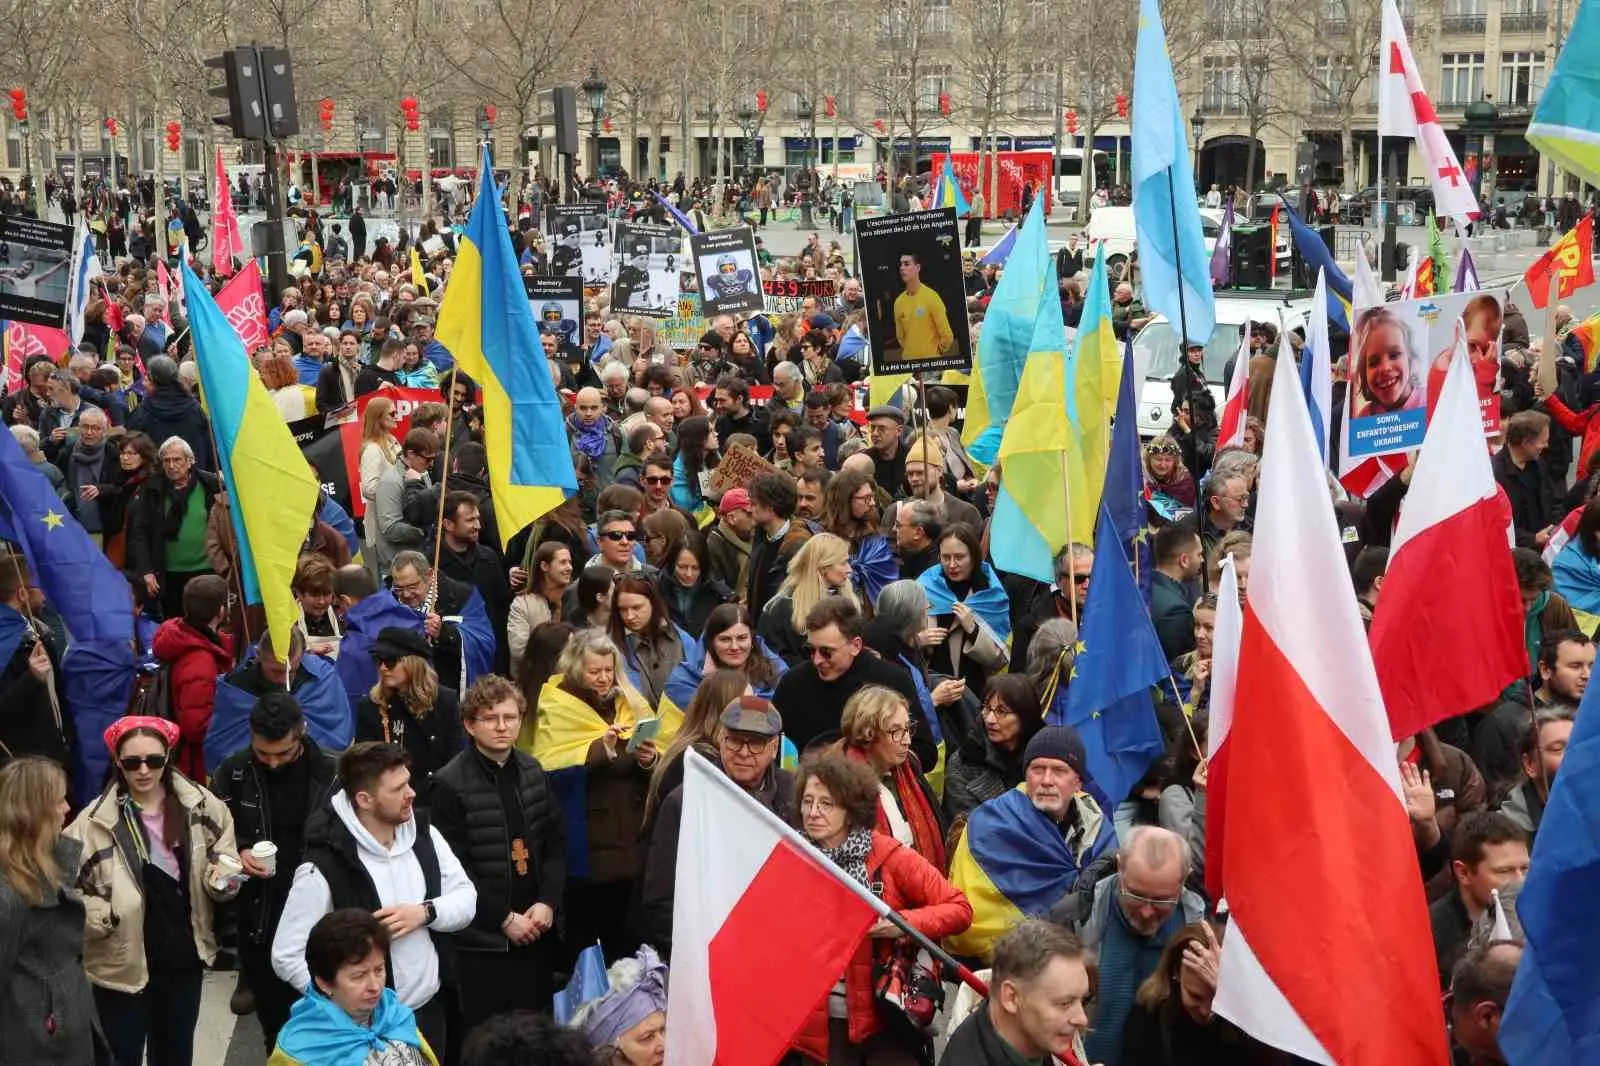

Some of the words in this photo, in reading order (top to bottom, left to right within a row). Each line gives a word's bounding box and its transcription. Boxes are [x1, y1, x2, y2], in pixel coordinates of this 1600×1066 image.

[920, 222, 930, 230] Los
[931, 220, 954, 229] Angeles
[930, 359, 948, 367] soldat
[1373, 435, 1403, 447] UKRAINE
